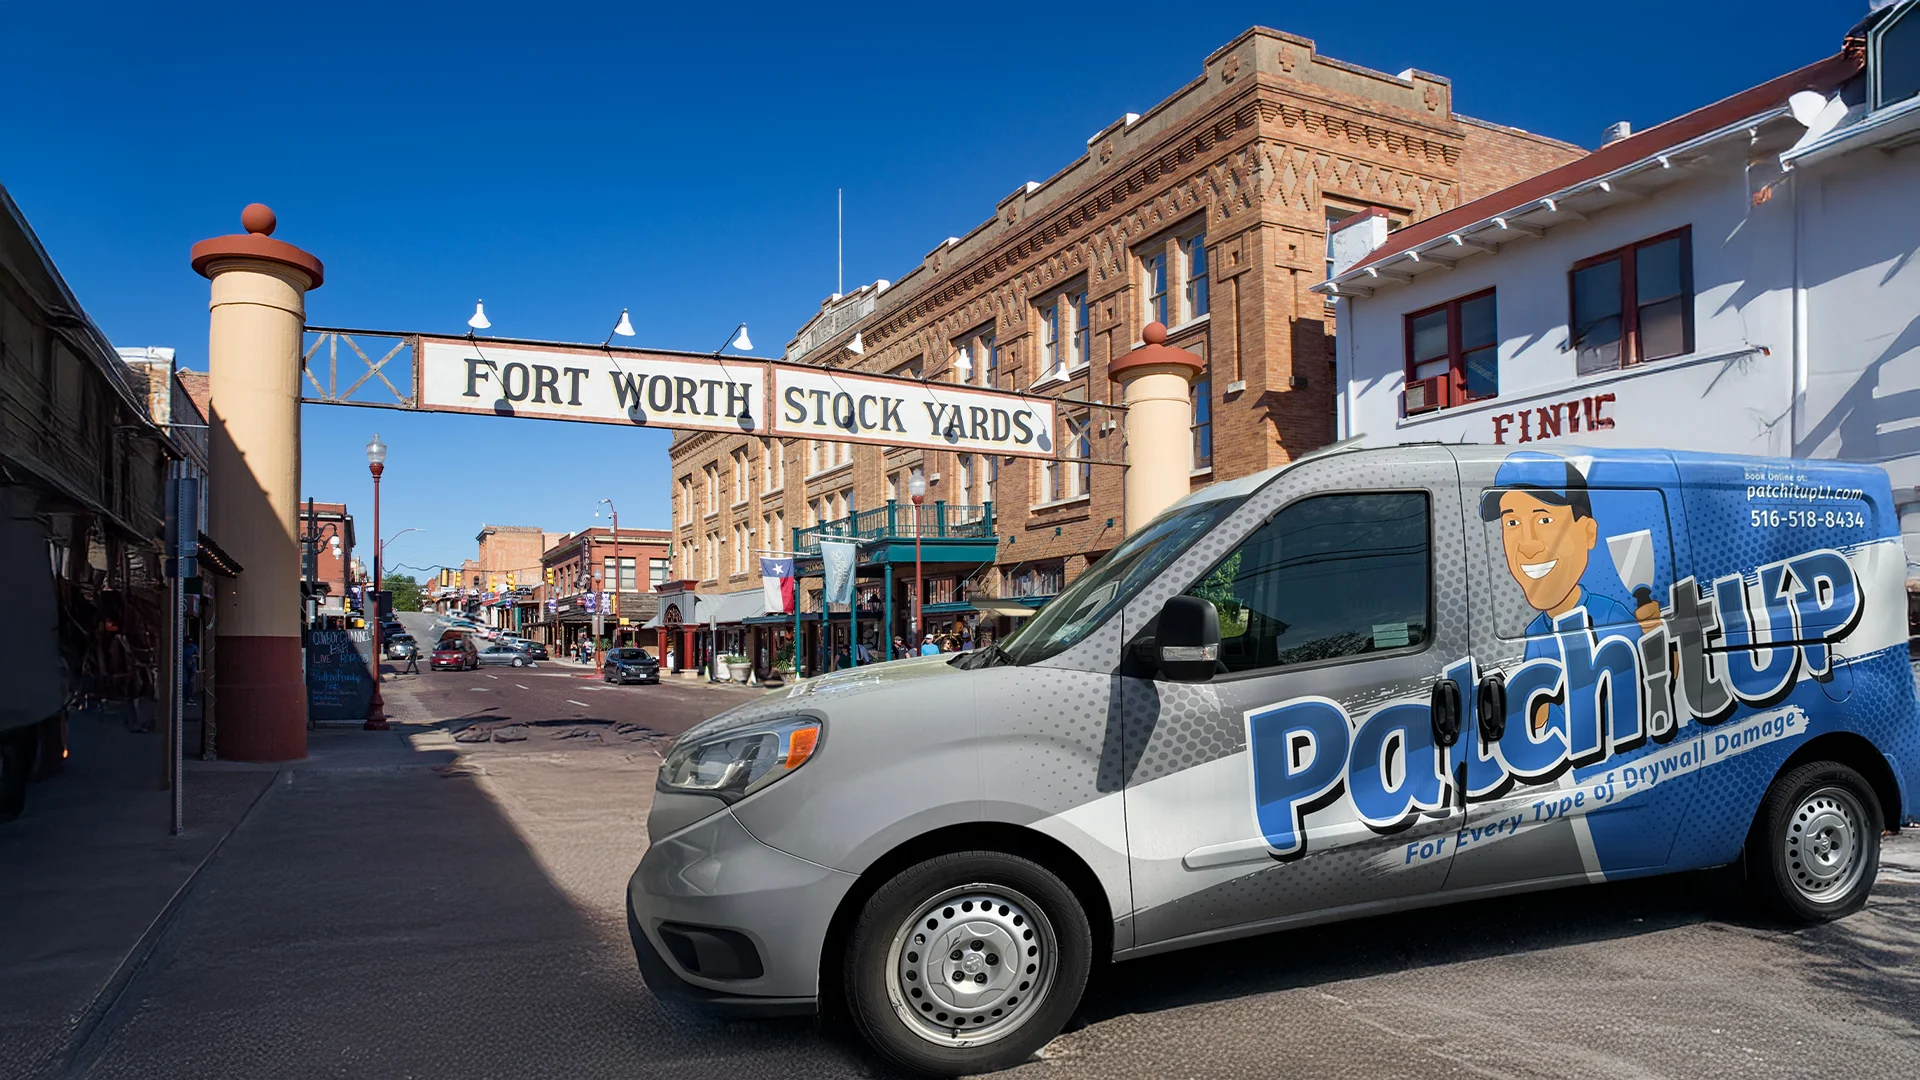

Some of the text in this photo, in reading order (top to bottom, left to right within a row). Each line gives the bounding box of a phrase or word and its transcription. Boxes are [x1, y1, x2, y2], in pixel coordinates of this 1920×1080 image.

[462, 358, 1034, 444] FORT WORTH STOCK YARDS
[1750, 508, 1865, 528] 516-518-8434
[1405, 711, 1796, 865] For Every Type of Drywall Damage
